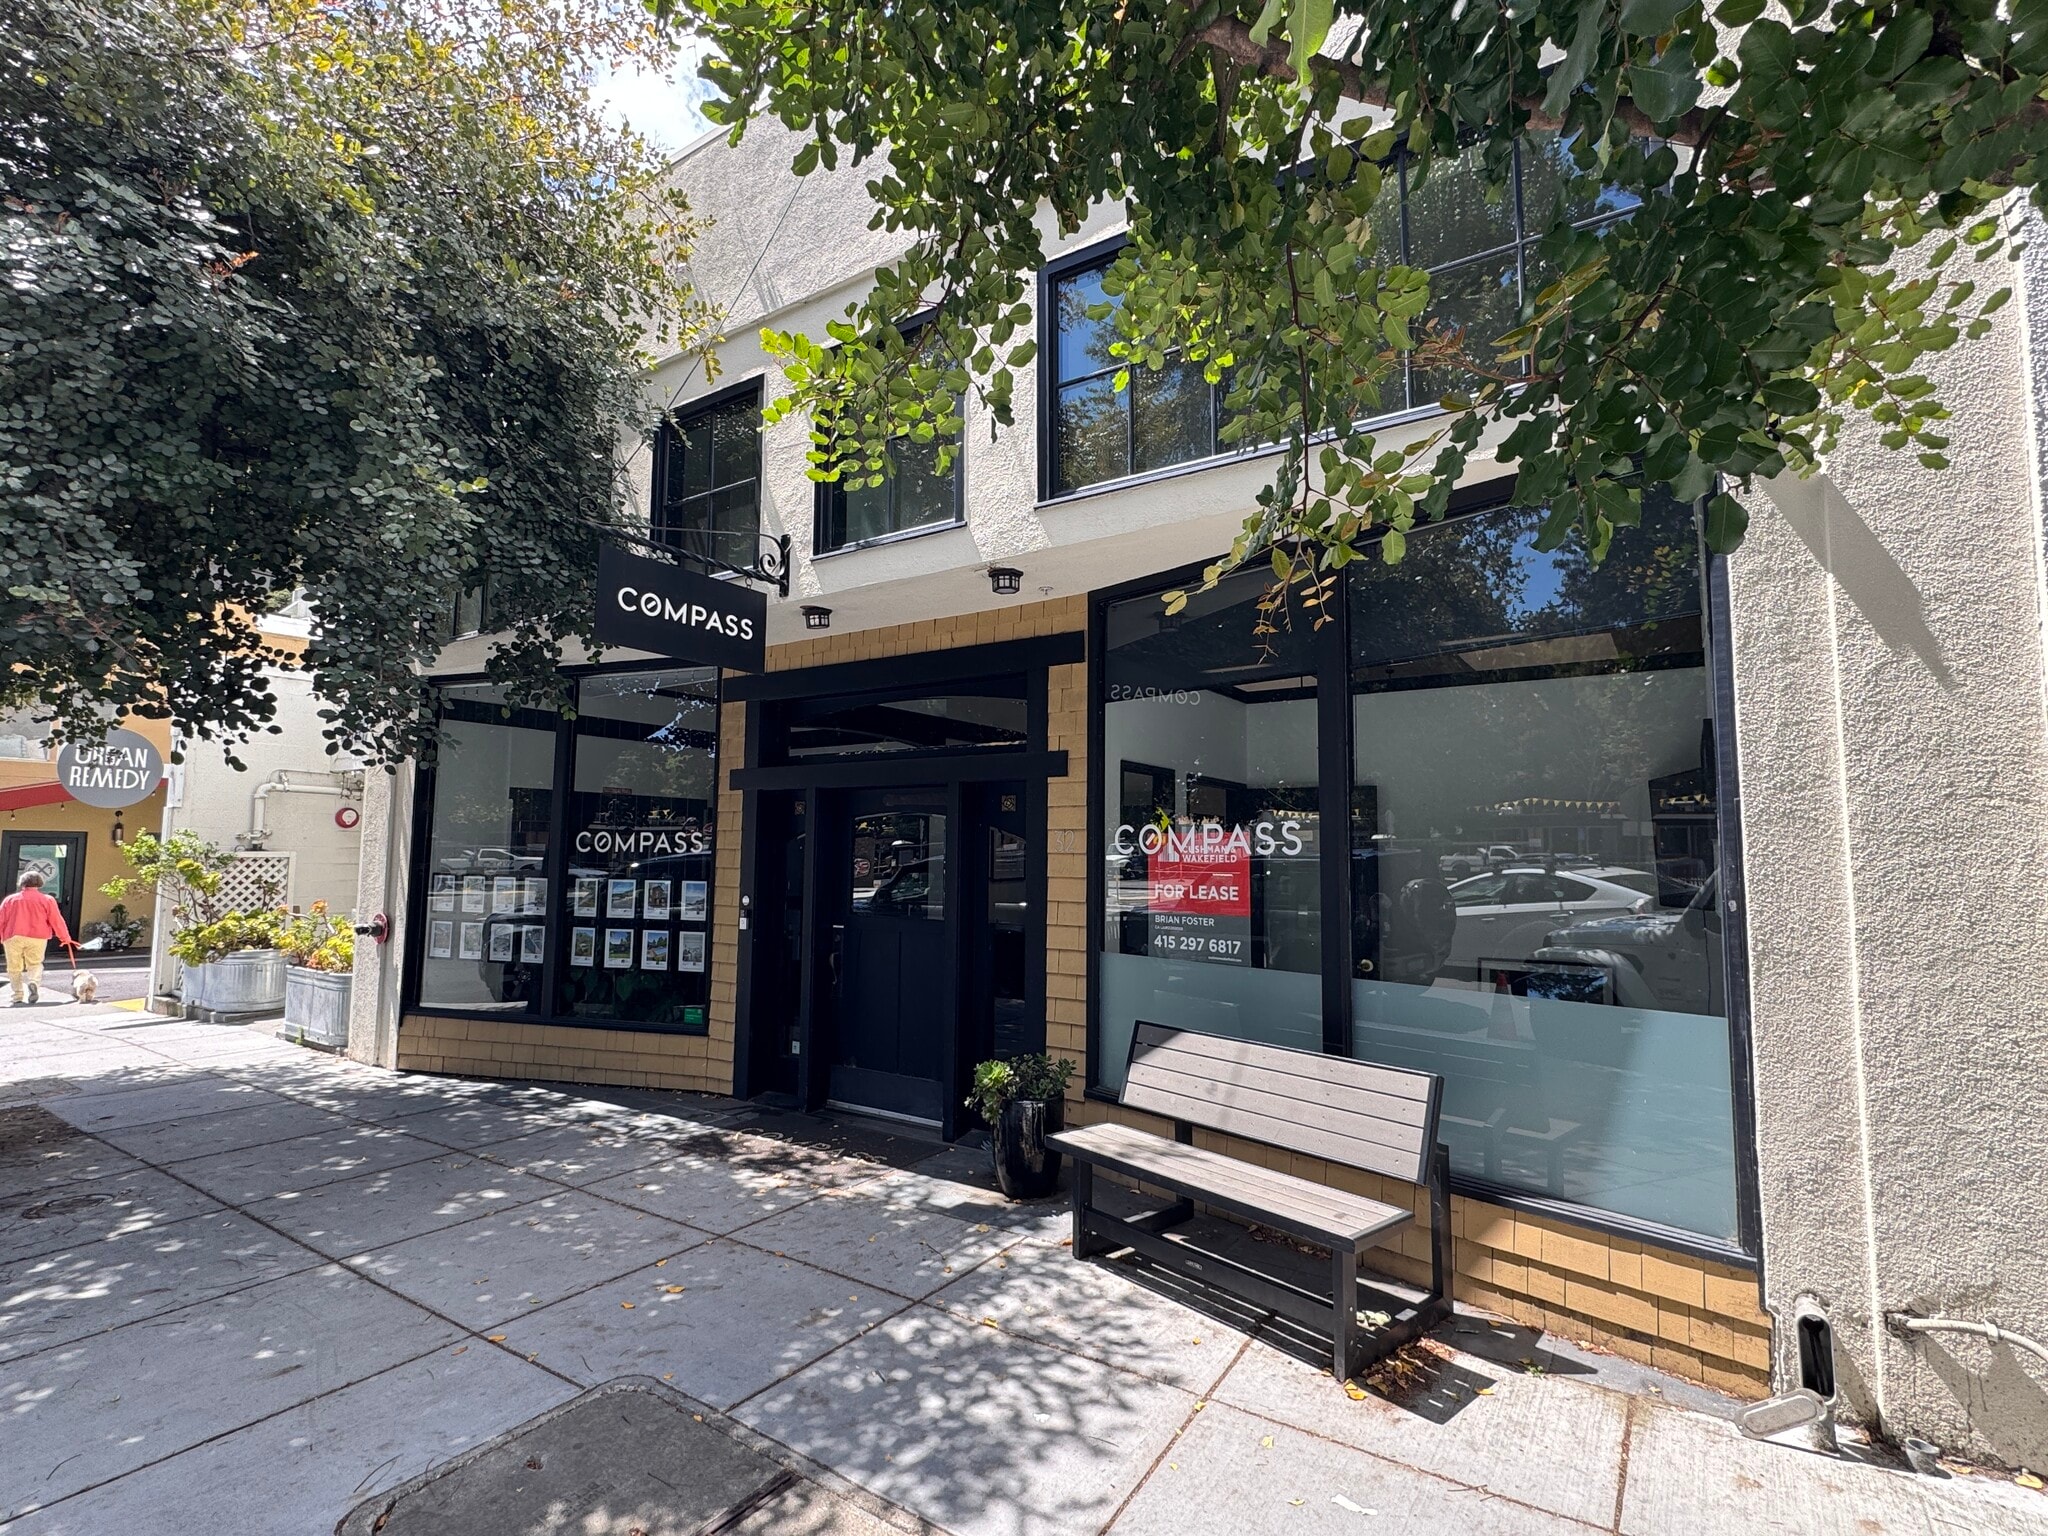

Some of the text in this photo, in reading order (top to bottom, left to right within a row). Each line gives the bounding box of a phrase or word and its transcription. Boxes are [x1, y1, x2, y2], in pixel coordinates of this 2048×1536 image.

[617, 587, 754, 641] COMPASS
[69, 766, 151, 790] REMEDY
[575, 831, 703, 853] COMPASS
[1114, 820, 1303, 856] COMPASS
[1182, 854, 1238, 863] WAKEFIELD
[1154, 884, 1240, 901] FOR LEASE
[1154, 914, 1215, 927] BRIAN FOSTER
[1154, 934, 1242, 955] 415 297 6817
